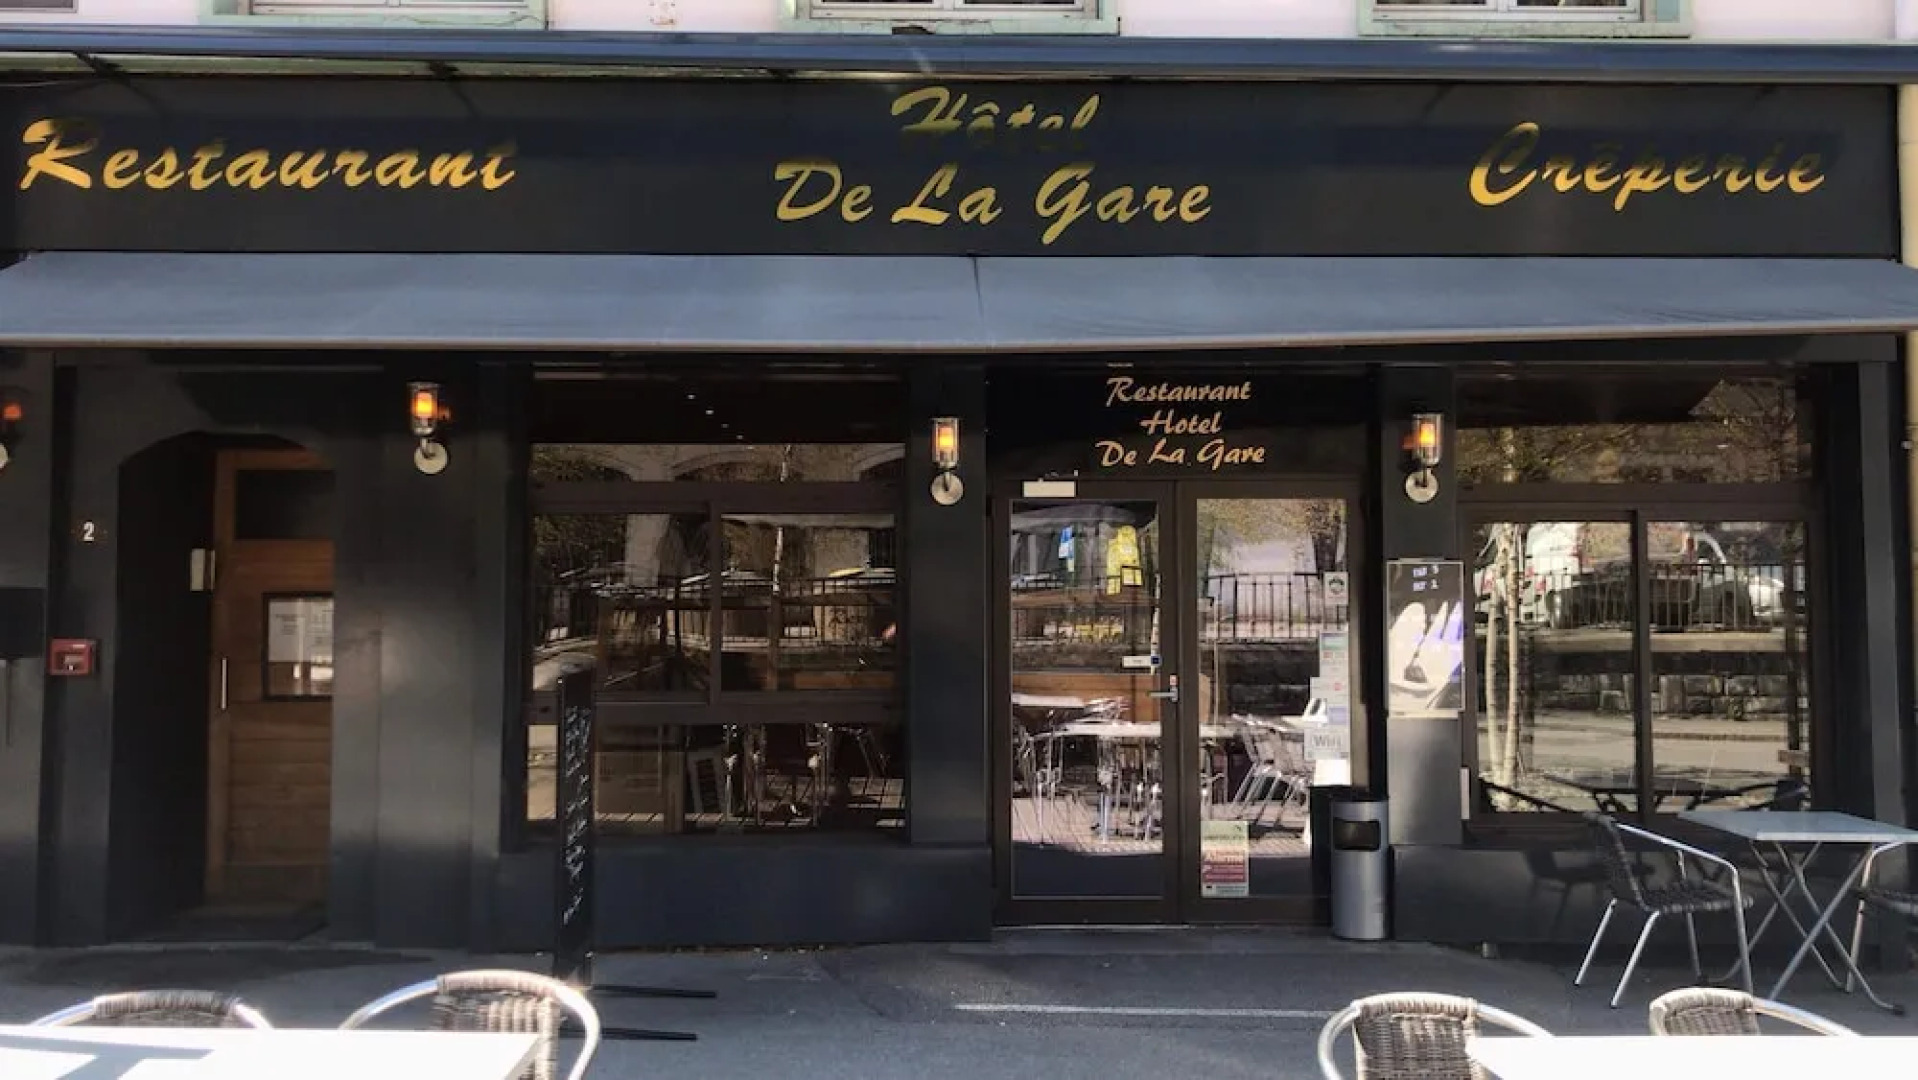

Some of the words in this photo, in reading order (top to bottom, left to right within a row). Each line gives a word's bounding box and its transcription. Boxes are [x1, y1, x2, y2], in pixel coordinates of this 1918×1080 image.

[890, 86, 1100, 152] Hôtel
[20, 117, 516, 191] Restaurant
[1469, 121, 1826, 212] Crêperie
[774, 159, 874, 222] De
[890, 162, 1002, 225] La
[1034, 162, 1212, 245] Gare
[1105, 375, 1252, 408] Restaurant
[1139, 408, 1223, 436] Hotel
[1095, 440, 1138, 468] De
[1146, 437, 1185, 465] La
[1196, 438, 1266, 471] Gare
[83, 520, 96, 542] 2
